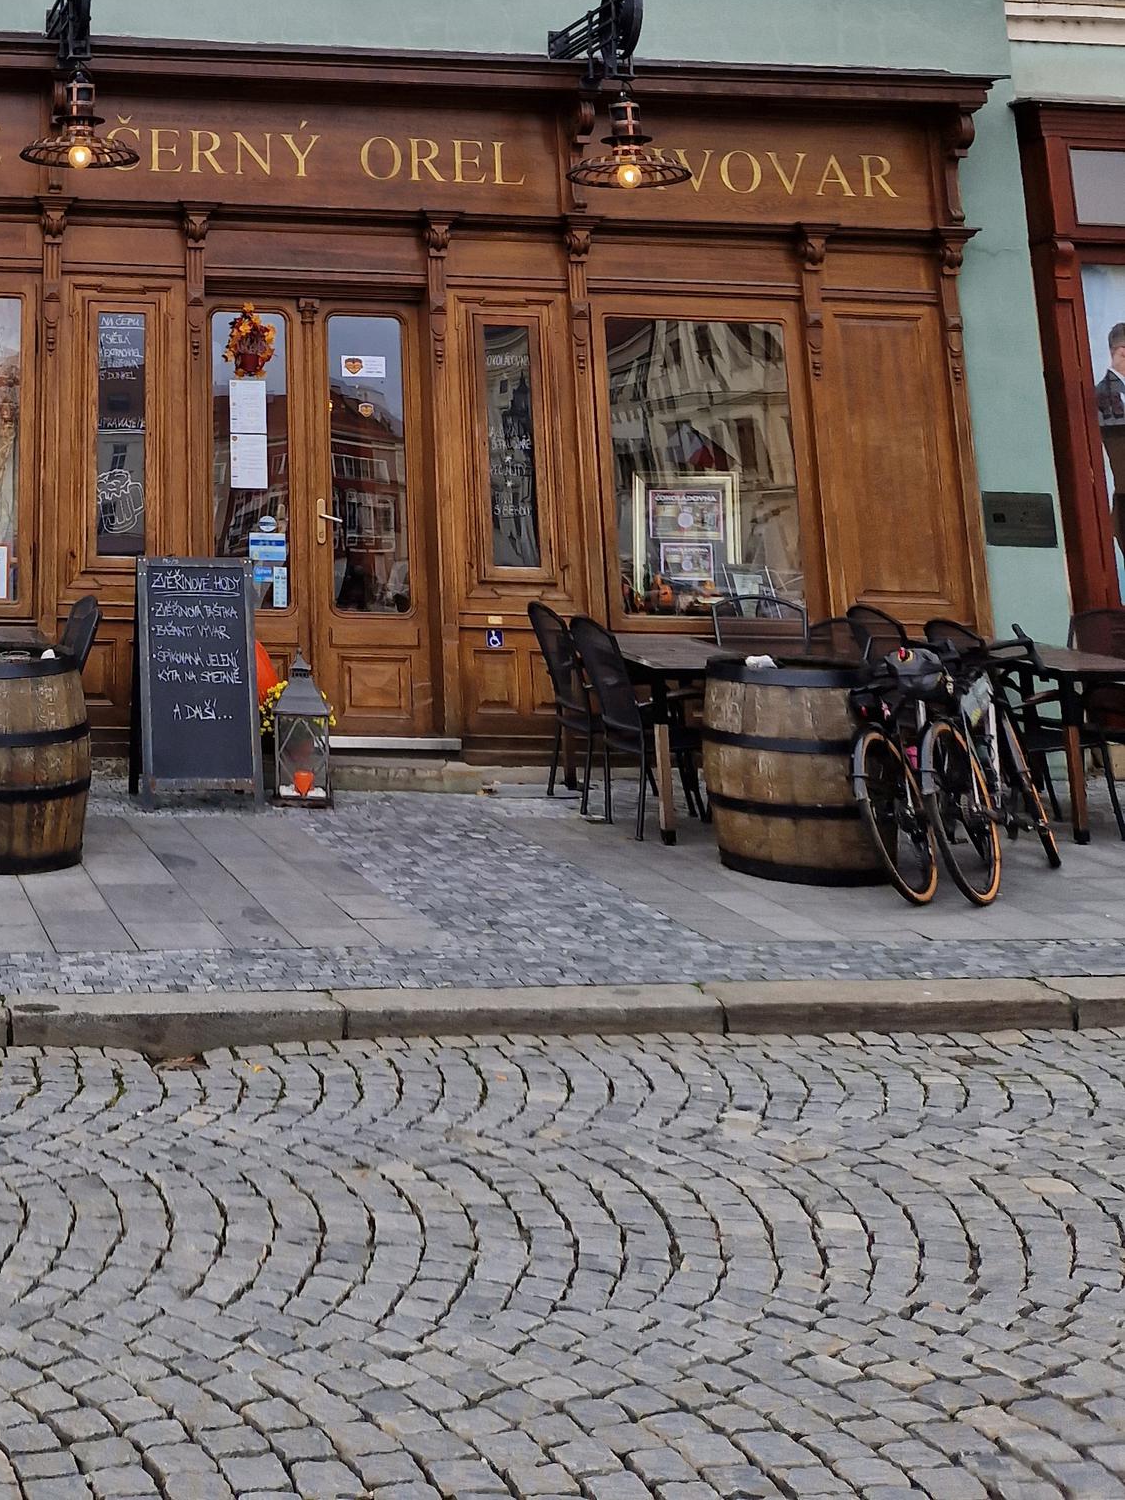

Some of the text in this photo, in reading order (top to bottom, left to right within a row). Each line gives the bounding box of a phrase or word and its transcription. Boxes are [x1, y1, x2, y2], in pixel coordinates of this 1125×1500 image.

[106, 113, 321, 178] ČERNÝ
[360, 136, 525, 186] OREL
[101, 316, 114, 326] NA
[151, 568, 241, 592] ZVĚŘINOVÉ HODY
[184, 671, 197, 683] NA
[173, 703, 182, 720] A
